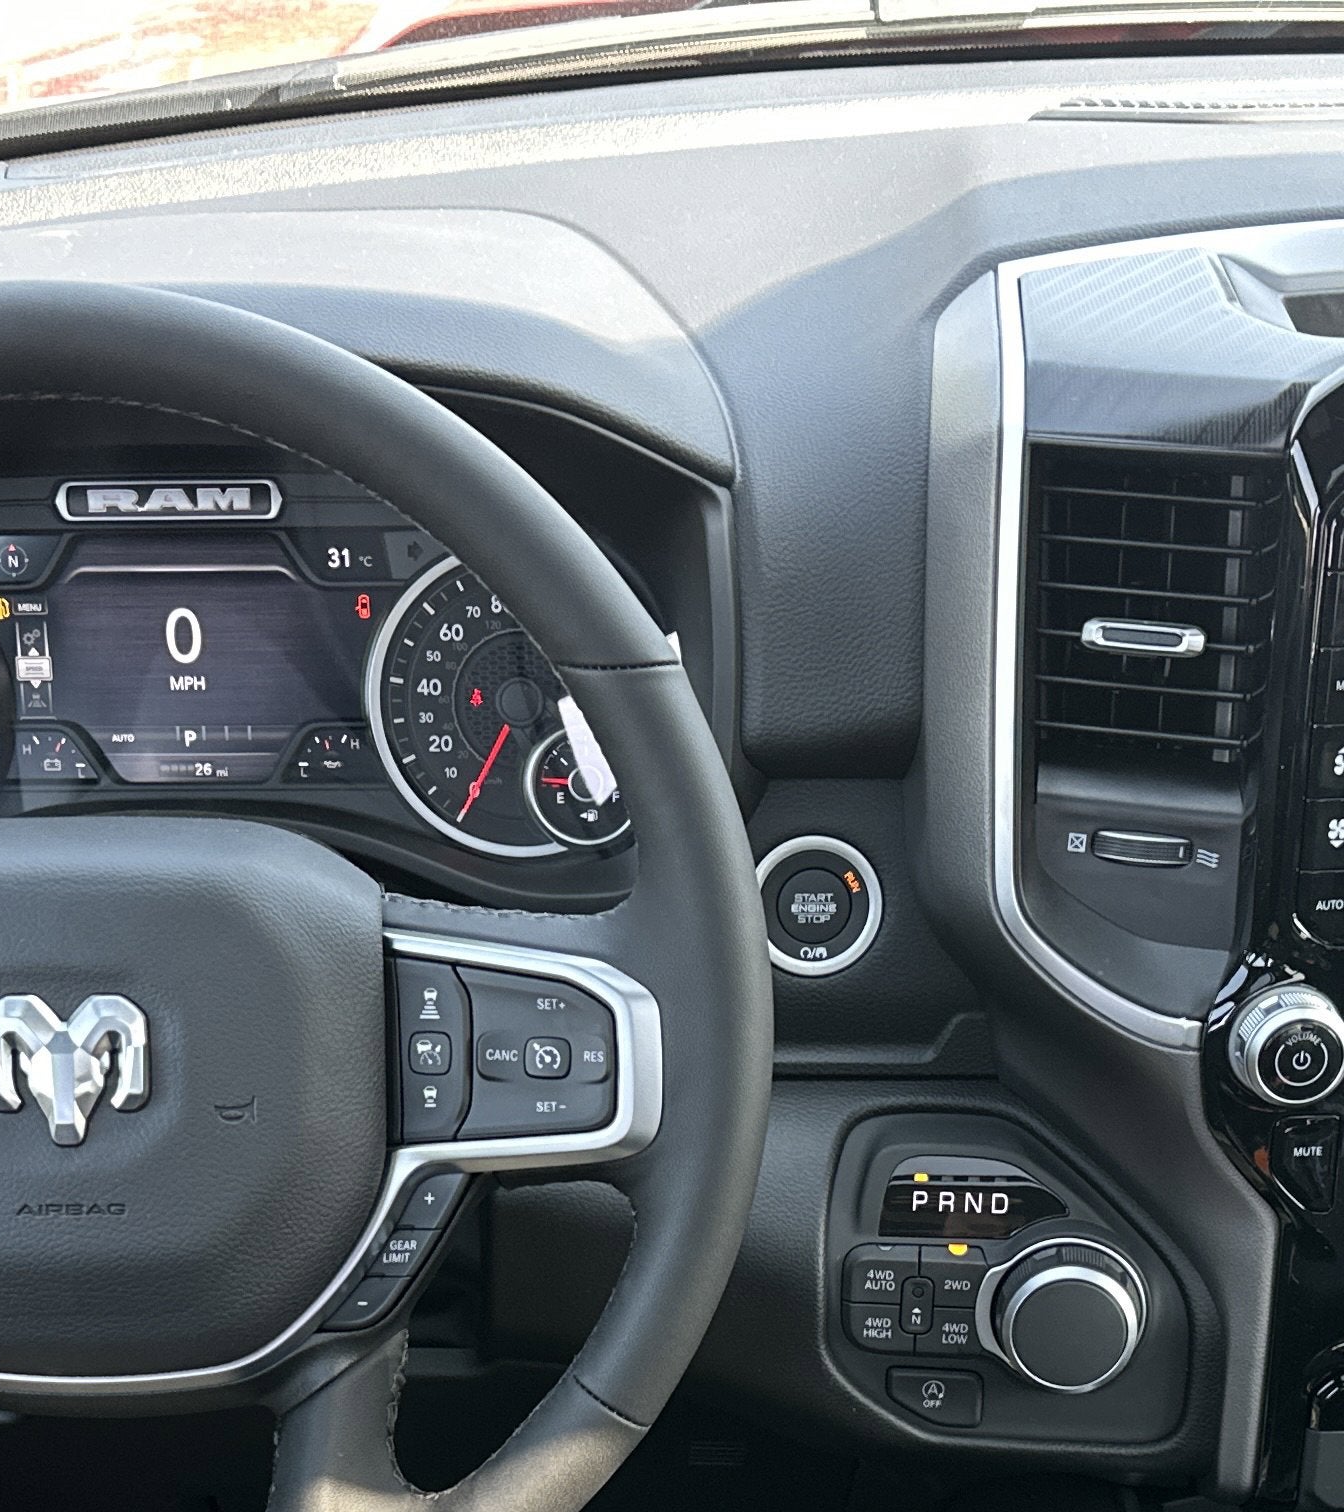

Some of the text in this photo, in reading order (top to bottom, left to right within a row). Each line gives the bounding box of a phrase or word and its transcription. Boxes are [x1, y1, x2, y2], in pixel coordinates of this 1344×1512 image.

[86, 487, 251, 513] RAM
[8, 555, 19, 568] N
[327, 547, 351, 568] 31
[17, 603, 42, 612] MENU
[465, 606, 481, 618] 70
[486, 621, 502, 630] 120
[165, 607, 202, 664] 0
[439, 623, 464, 641] 60
[426, 650, 441, 662] 50
[169, 676, 206, 691] MPH
[417, 678, 442, 696] 40
[419, 712, 434, 723] 30
[111, 733, 135, 742] AUTO
[184, 730, 197, 747] P
[428, 735, 453, 752] 20
[216, 766, 229, 777] mi
[444, 767, 457, 778] 10
[557, 792, 565, 803] E
[612, 791, 620, 803] F
[794, 893, 833, 903] START
[791, 904, 837, 913] ENGINE
[1315, 900, 1344, 911] AUTO
[797, 914, 831, 924] STOP
[1285, 1031, 1322, 1047] VOLUME
[485, 1049, 518, 1062] CANC
[583, 1051, 604, 1063] RES
[1293, 1146, 1323, 1157] MUTE
[15, 1202, 127, 1217] AIRBAG
[389, 1240, 417, 1251] GEAR
[382, 1252, 411, 1264] LIMIT
[867, 1270, 894, 1281] 4WD
[864, 1280, 895, 1291] AUTO
[944, 1280, 971, 1291] 2WD
[865, 1317, 892, 1328] 4WD
[912, 1314, 921, 1325] N
[863, 1328, 892, 1339] HIGH
[942, 1323, 969, 1334] 4WD
[942, 1334, 968, 1344] LOW
[923, 1400, 943, 1408] OFF
